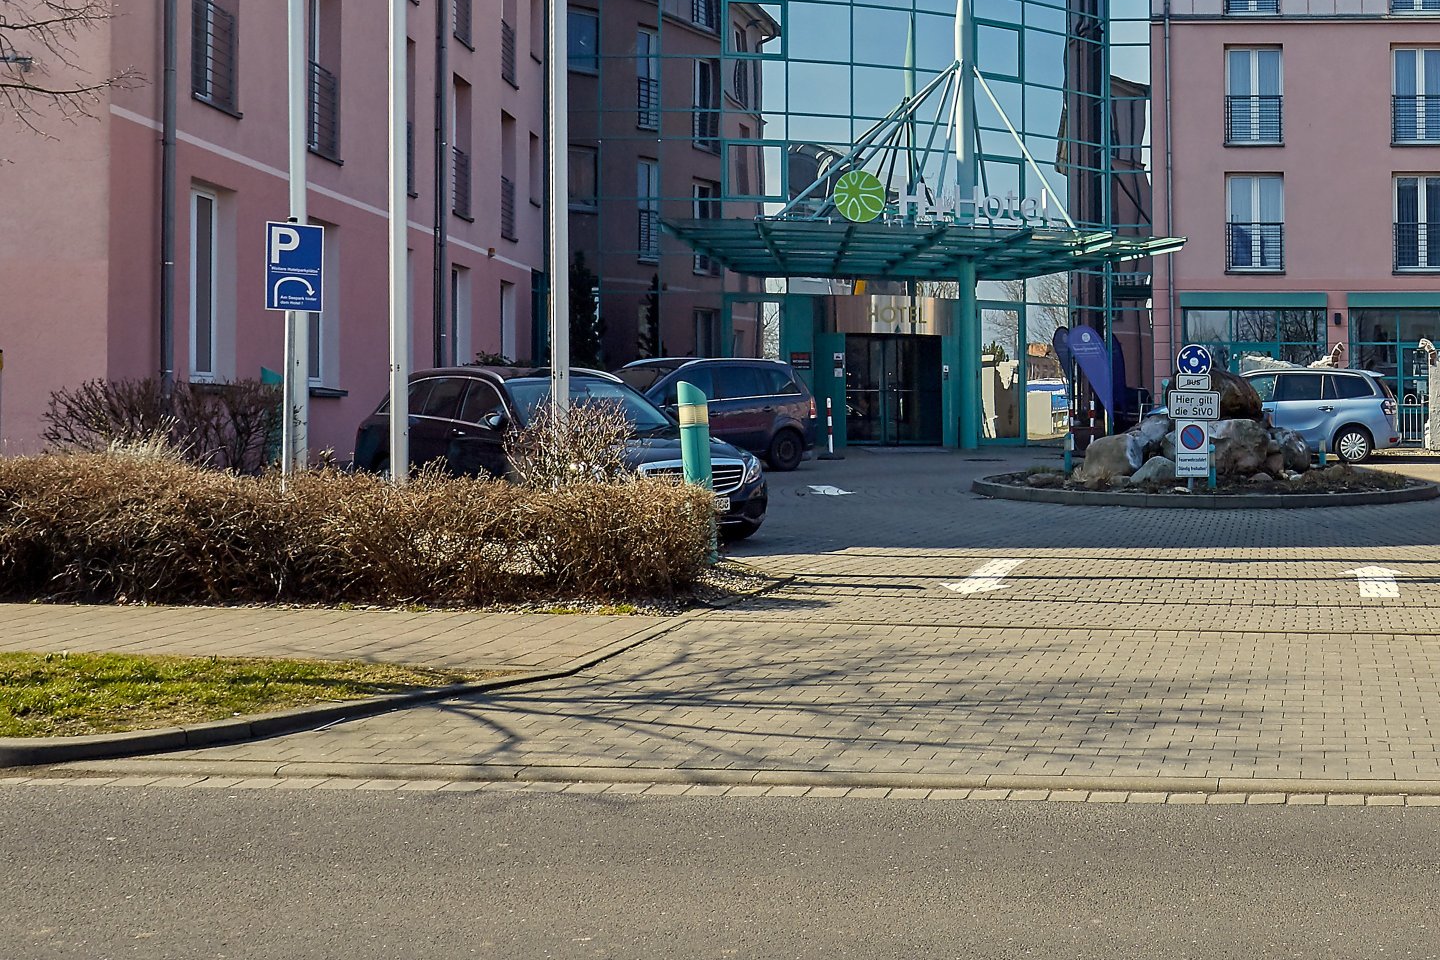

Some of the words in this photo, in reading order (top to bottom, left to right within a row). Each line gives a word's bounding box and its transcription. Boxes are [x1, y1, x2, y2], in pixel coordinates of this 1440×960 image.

[271, 226, 300, 264] P
[865, 305, 927, 323] HOTEL
[1176, 395, 1195, 404] Hier
[1198, 395, 1213, 407] gilt
[1175, 407, 1188, 416] die
[1192, 407, 1214, 417] StVO
